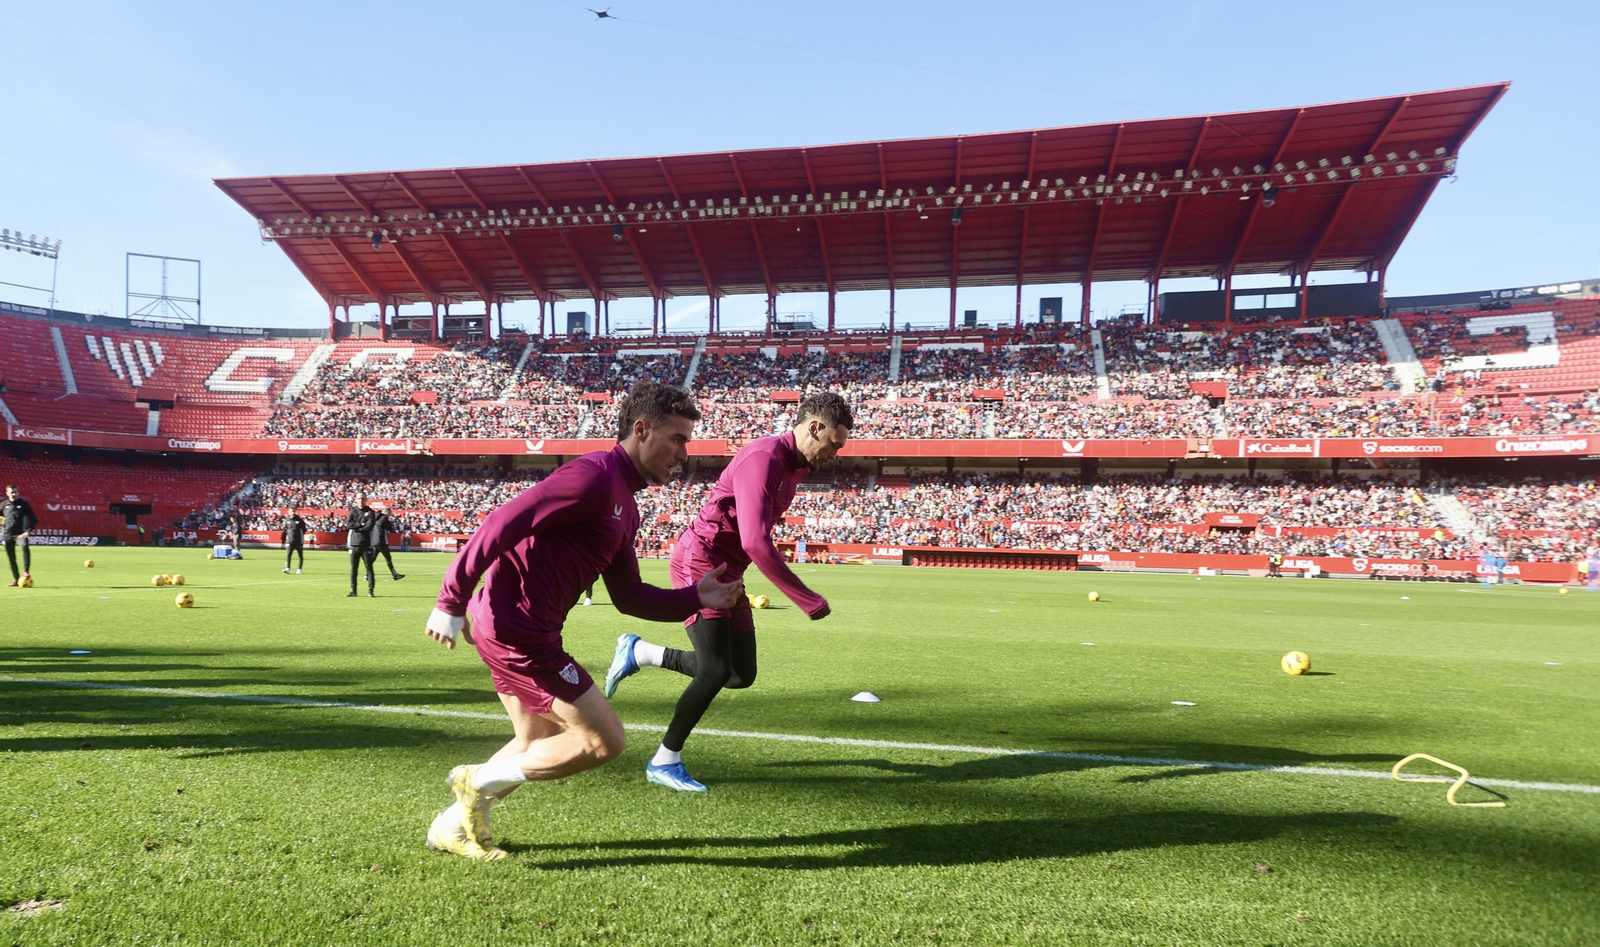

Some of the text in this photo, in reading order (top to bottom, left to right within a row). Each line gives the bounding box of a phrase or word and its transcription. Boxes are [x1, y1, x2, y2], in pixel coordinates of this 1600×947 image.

[21, 305, 47, 316] escudo
[130, 320, 154, 328] orgullo
[26, 430, 67, 441] CaixaBank
[168, 438, 221, 450] Cruzcampo
[371, 442, 406, 450] CaixaBank
[1261, 443, 1313, 453] CaixaBank
[1495, 438, 1587, 452] Cruzcampo
